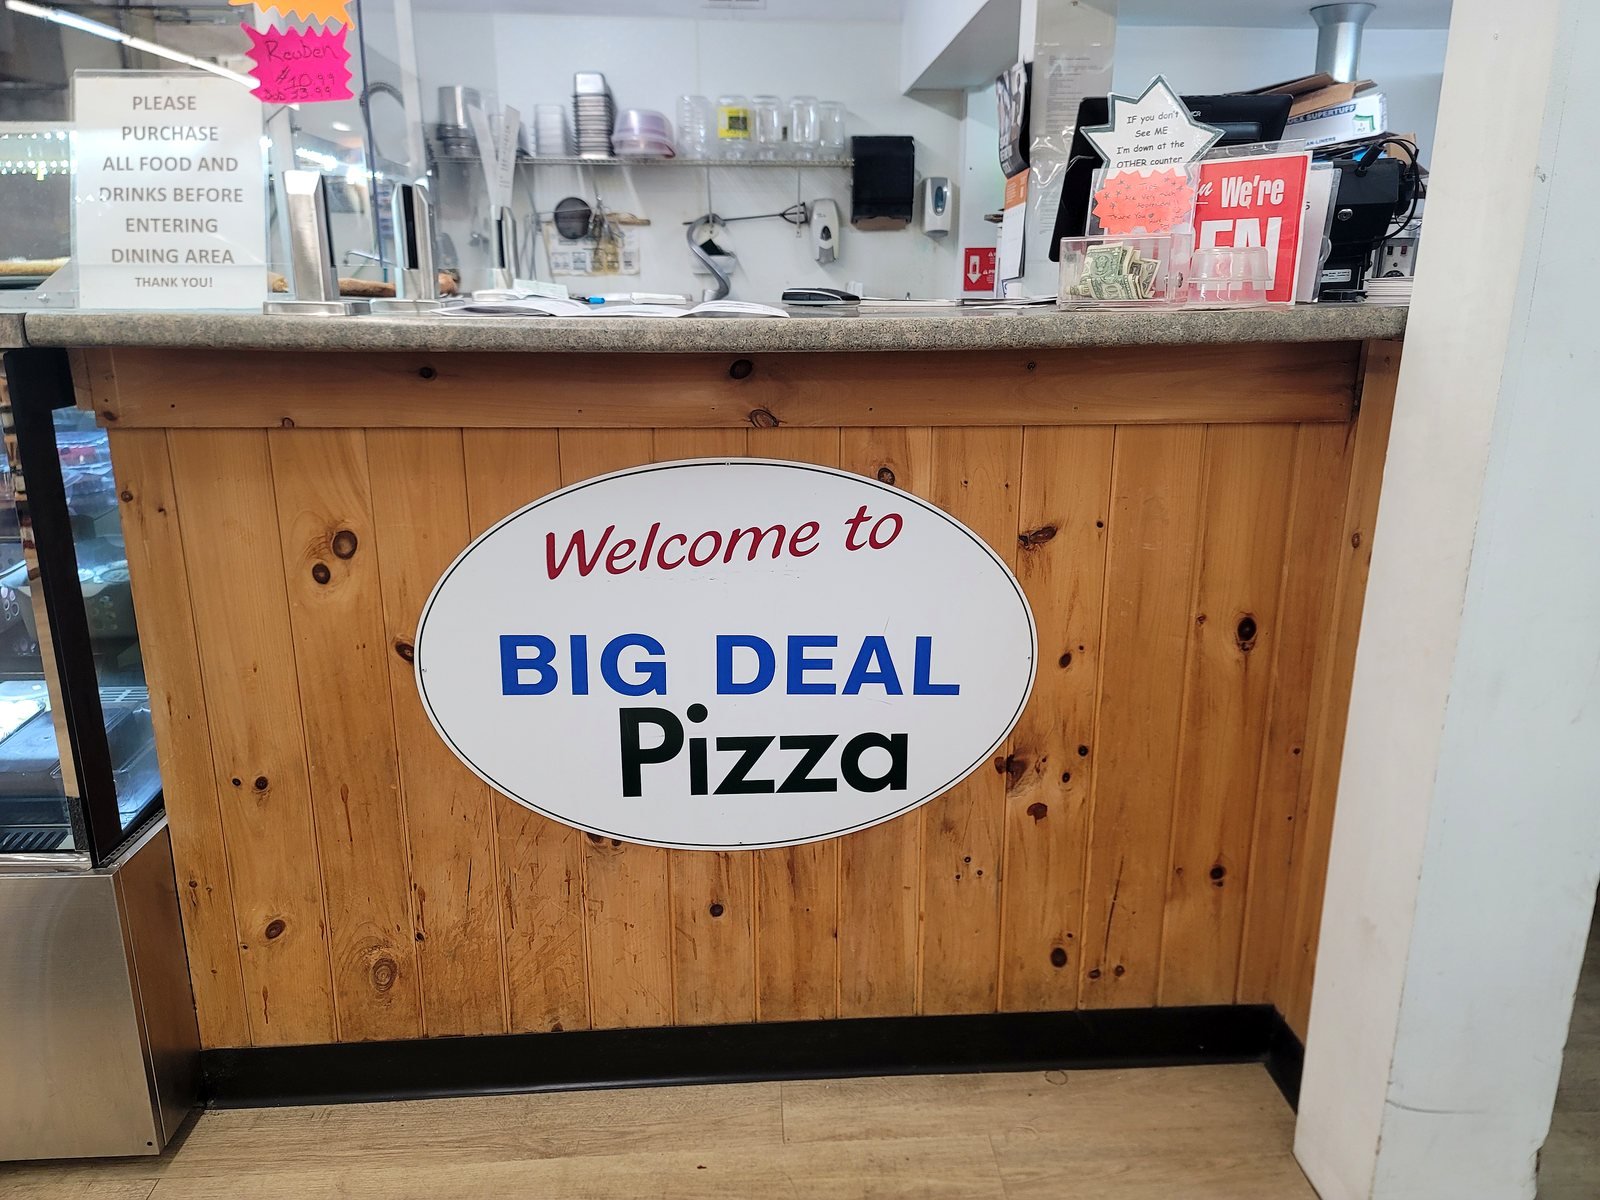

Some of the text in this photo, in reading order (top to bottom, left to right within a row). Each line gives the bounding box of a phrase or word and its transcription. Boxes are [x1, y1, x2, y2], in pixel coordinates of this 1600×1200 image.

[264, 40, 339, 61] Reuben
[132, 96, 197, 111] PLEASE
[1127, 110, 1179, 125] IF you don't
[122, 126, 219, 141] PURCHASE
[1135, 126, 1169, 138] See ME
[1117, 140, 1185, 155] I'm down at the
[103, 157, 238, 172] ALL FOOD AND
[1117, 155, 1183, 169] OTHER counter
[100, 187, 243, 203] DRINKS BEFORE
[1221, 175, 1285, 208] We're
[126, 218, 218, 233] ENTERING
[112, 249, 235, 264] DINING AREA
[135, 277, 213, 288] THANK YOU!
[545, 505, 904, 580] Welcome to
[499, 633, 961, 696] BIG DEAL
[619, 703, 909, 798] Pizza
